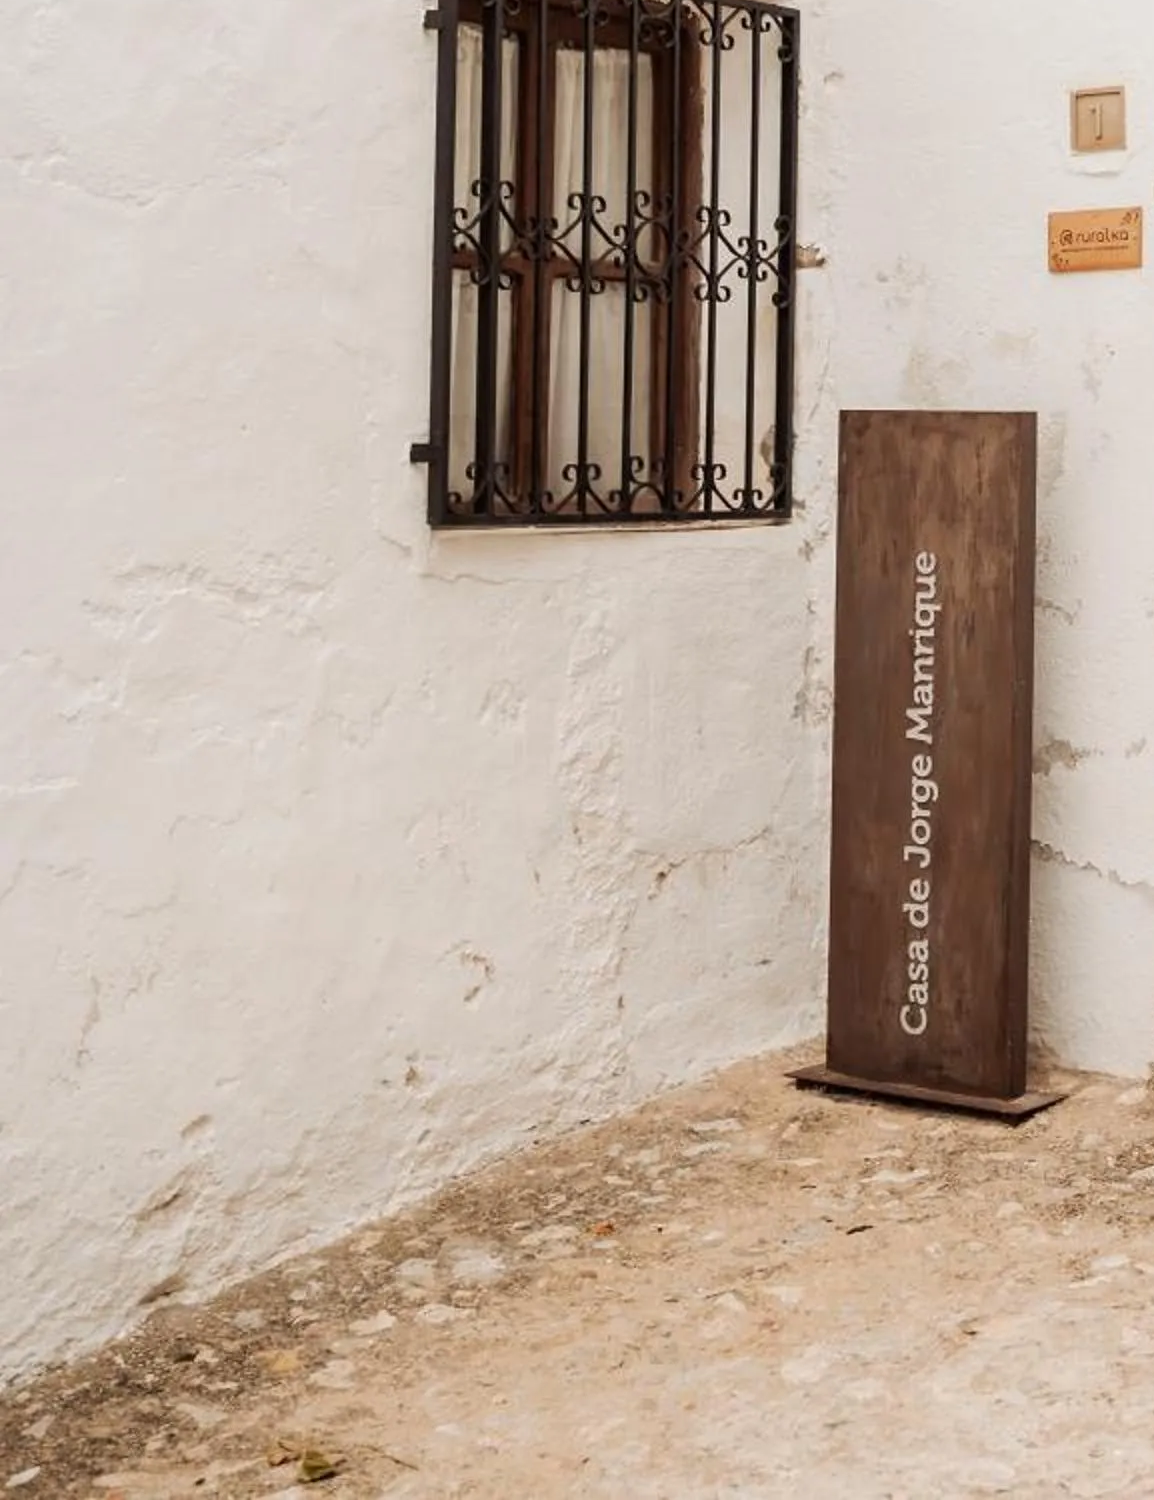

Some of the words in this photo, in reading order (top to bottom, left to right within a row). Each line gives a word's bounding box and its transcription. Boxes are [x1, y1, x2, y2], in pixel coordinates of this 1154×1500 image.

[1059, 227, 1129, 247] @ruralka
[905, 550, 943, 746] Manrique
[903, 753, 939, 869] Jorge
[902, 878, 930, 928] de
[900, 938, 930, 1036] Casa
